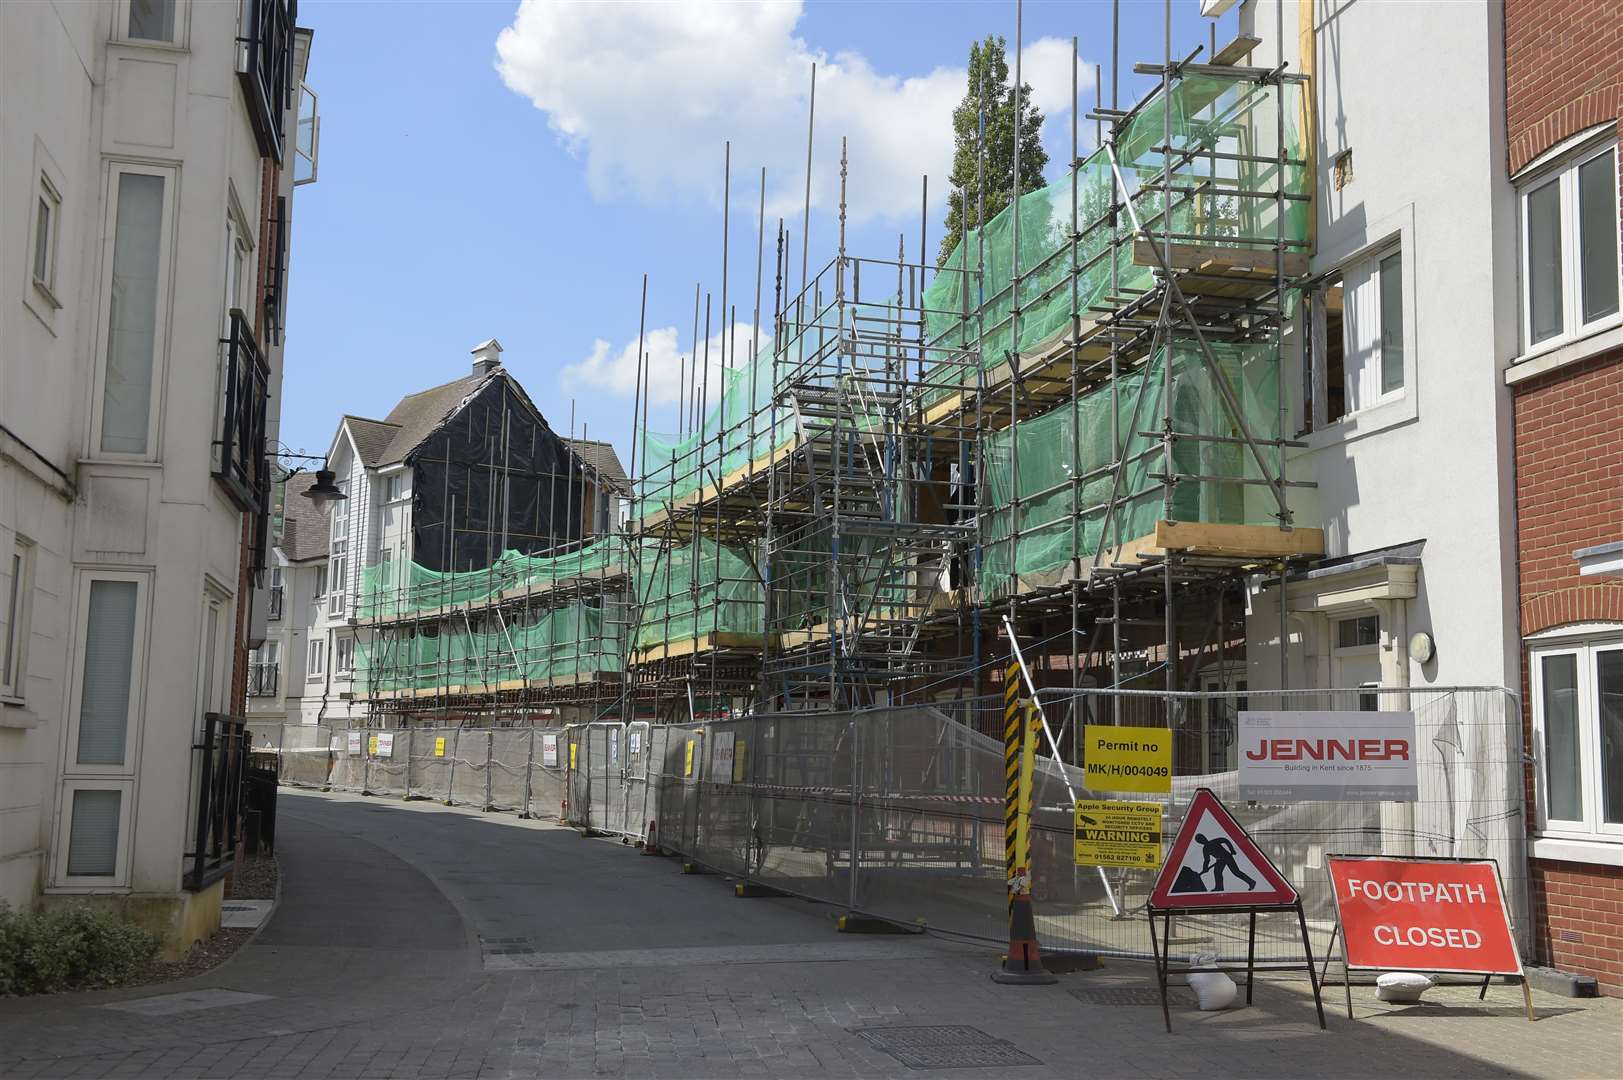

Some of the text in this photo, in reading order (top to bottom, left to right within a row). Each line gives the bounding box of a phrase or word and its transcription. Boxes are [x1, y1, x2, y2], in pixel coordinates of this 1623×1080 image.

[1097, 739, 1159, 752] Permit no
[1246, 738, 1410, 761] JENNER
[1087, 764, 1169, 777] MK/H/004049
[1284, 764, 1310, 772] Building
[1077, 803, 1160, 814] Apple Security Group
[1086, 830, 1150, 842] WARNING
[1347, 878, 1487, 905] FOOTPATH
[1373, 924, 1482, 950] CLOSED
